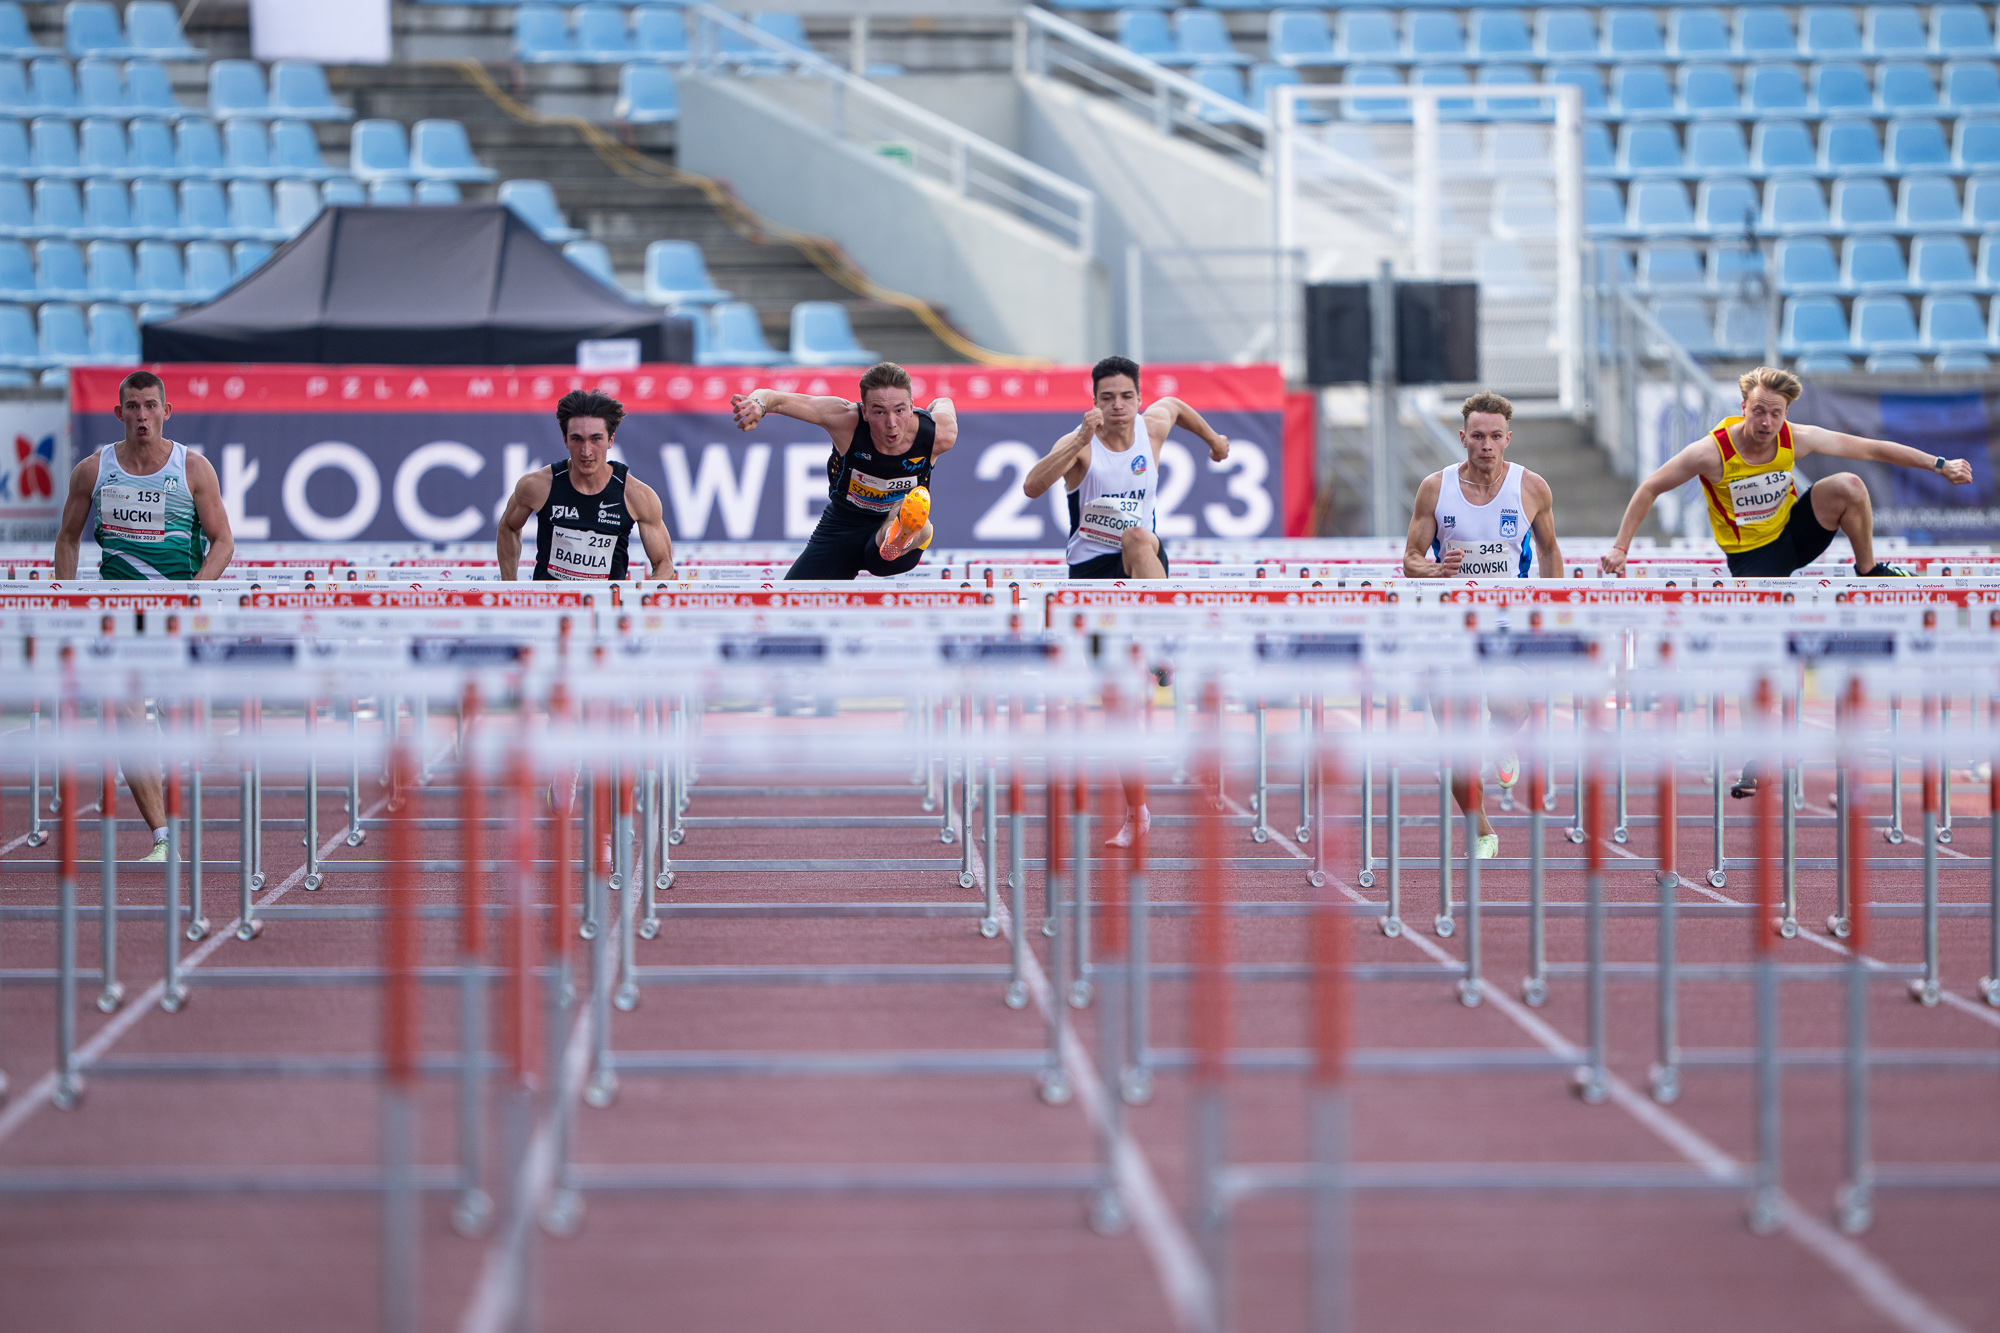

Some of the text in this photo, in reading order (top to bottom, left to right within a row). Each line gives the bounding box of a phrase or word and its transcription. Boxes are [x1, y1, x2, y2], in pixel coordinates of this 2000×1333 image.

[306, 375, 430, 399] PZLA
[911, 374, 1049, 398] OLSKI
[887, 480, 911, 490] 288
[1764, 471, 1786, 486] 135
[137, 490, 160, 503] 153
[972, 438, 1276, 542] 223
[1120, 501, 1139, 512] 337
[112, 508, 152, 523] ŁUCKI
[588, 536, 612, 549] 218
[1479, 543, 1503, 555] 343
[555, 547, 607, 568] BABULA
[1459, 560, 1508, 574] NKOWSKI
